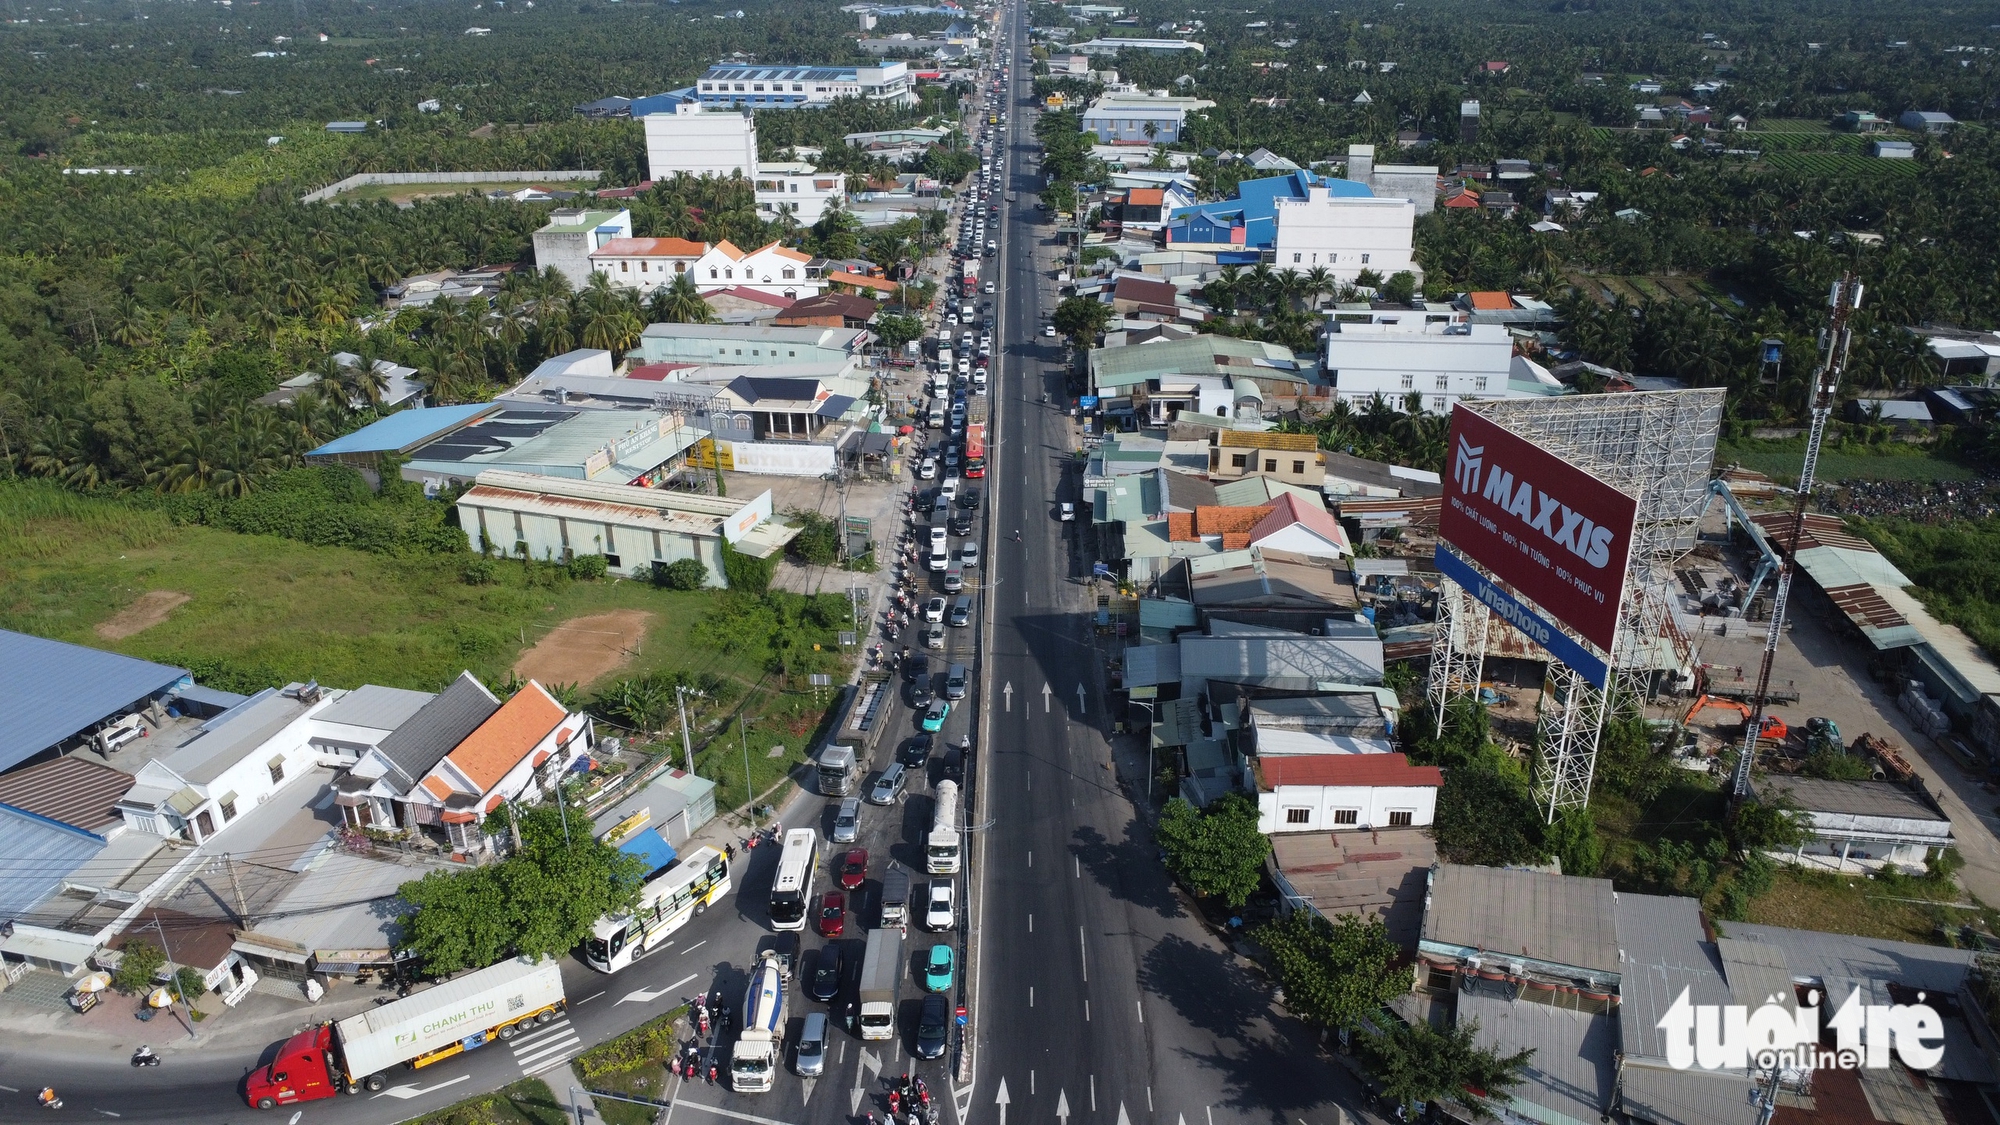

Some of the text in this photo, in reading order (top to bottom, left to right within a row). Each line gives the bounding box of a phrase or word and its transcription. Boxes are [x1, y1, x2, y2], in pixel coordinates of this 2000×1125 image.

[1482, 464, 1615, 569] MAXXIS
[1451, 496, 1464, 512] 100%
[1465, 506, 1478, 522] CHẤT
[1479, 518, 1497, 535] LƯỢNG
[1502, 530, 1518, 548] 100%
[1519, 541, 1529, 556] TIN
[1556, 565, 1573, 584] 100%
[1574, 578, 1592, 597] PHỤC
[1594, 589, 1605, 605] VỤ
[1478, 582, 1550, 644] vinaphone
[219, 964, 229, 976] XE
[470, 1001, 495, 1016] THU
